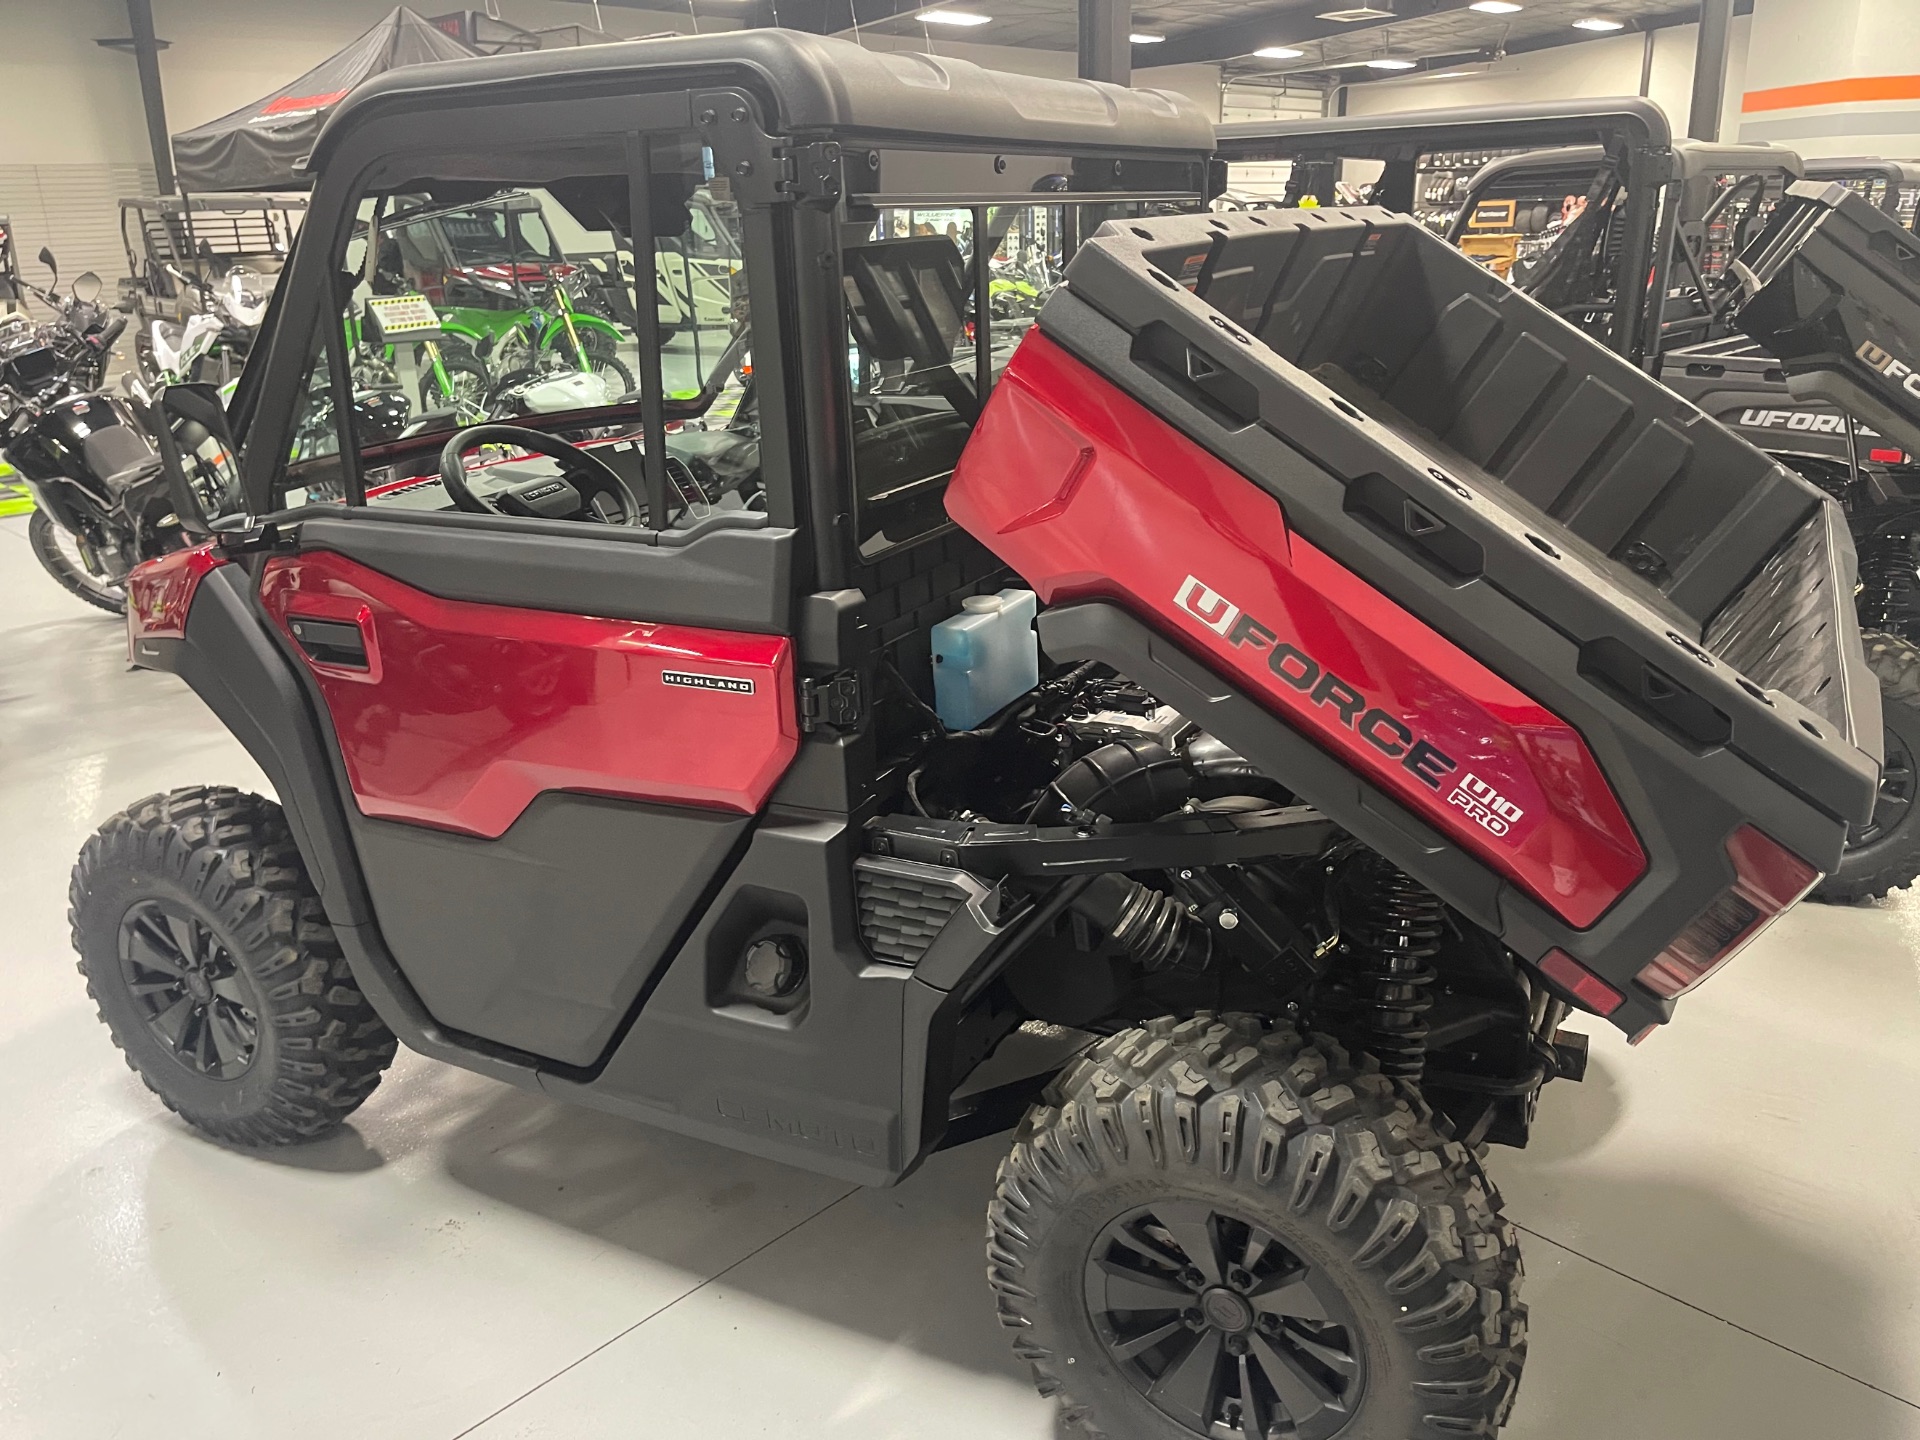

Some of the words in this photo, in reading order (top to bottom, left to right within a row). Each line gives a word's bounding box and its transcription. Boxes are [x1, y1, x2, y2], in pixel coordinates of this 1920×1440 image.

[664, 674, 750, 691] HIGHLAND
[1172, 574, 1457, 792] UFORCE
[1447, 788, 1510, 837] PRO
[1458, 773, 1523, 823] U10
